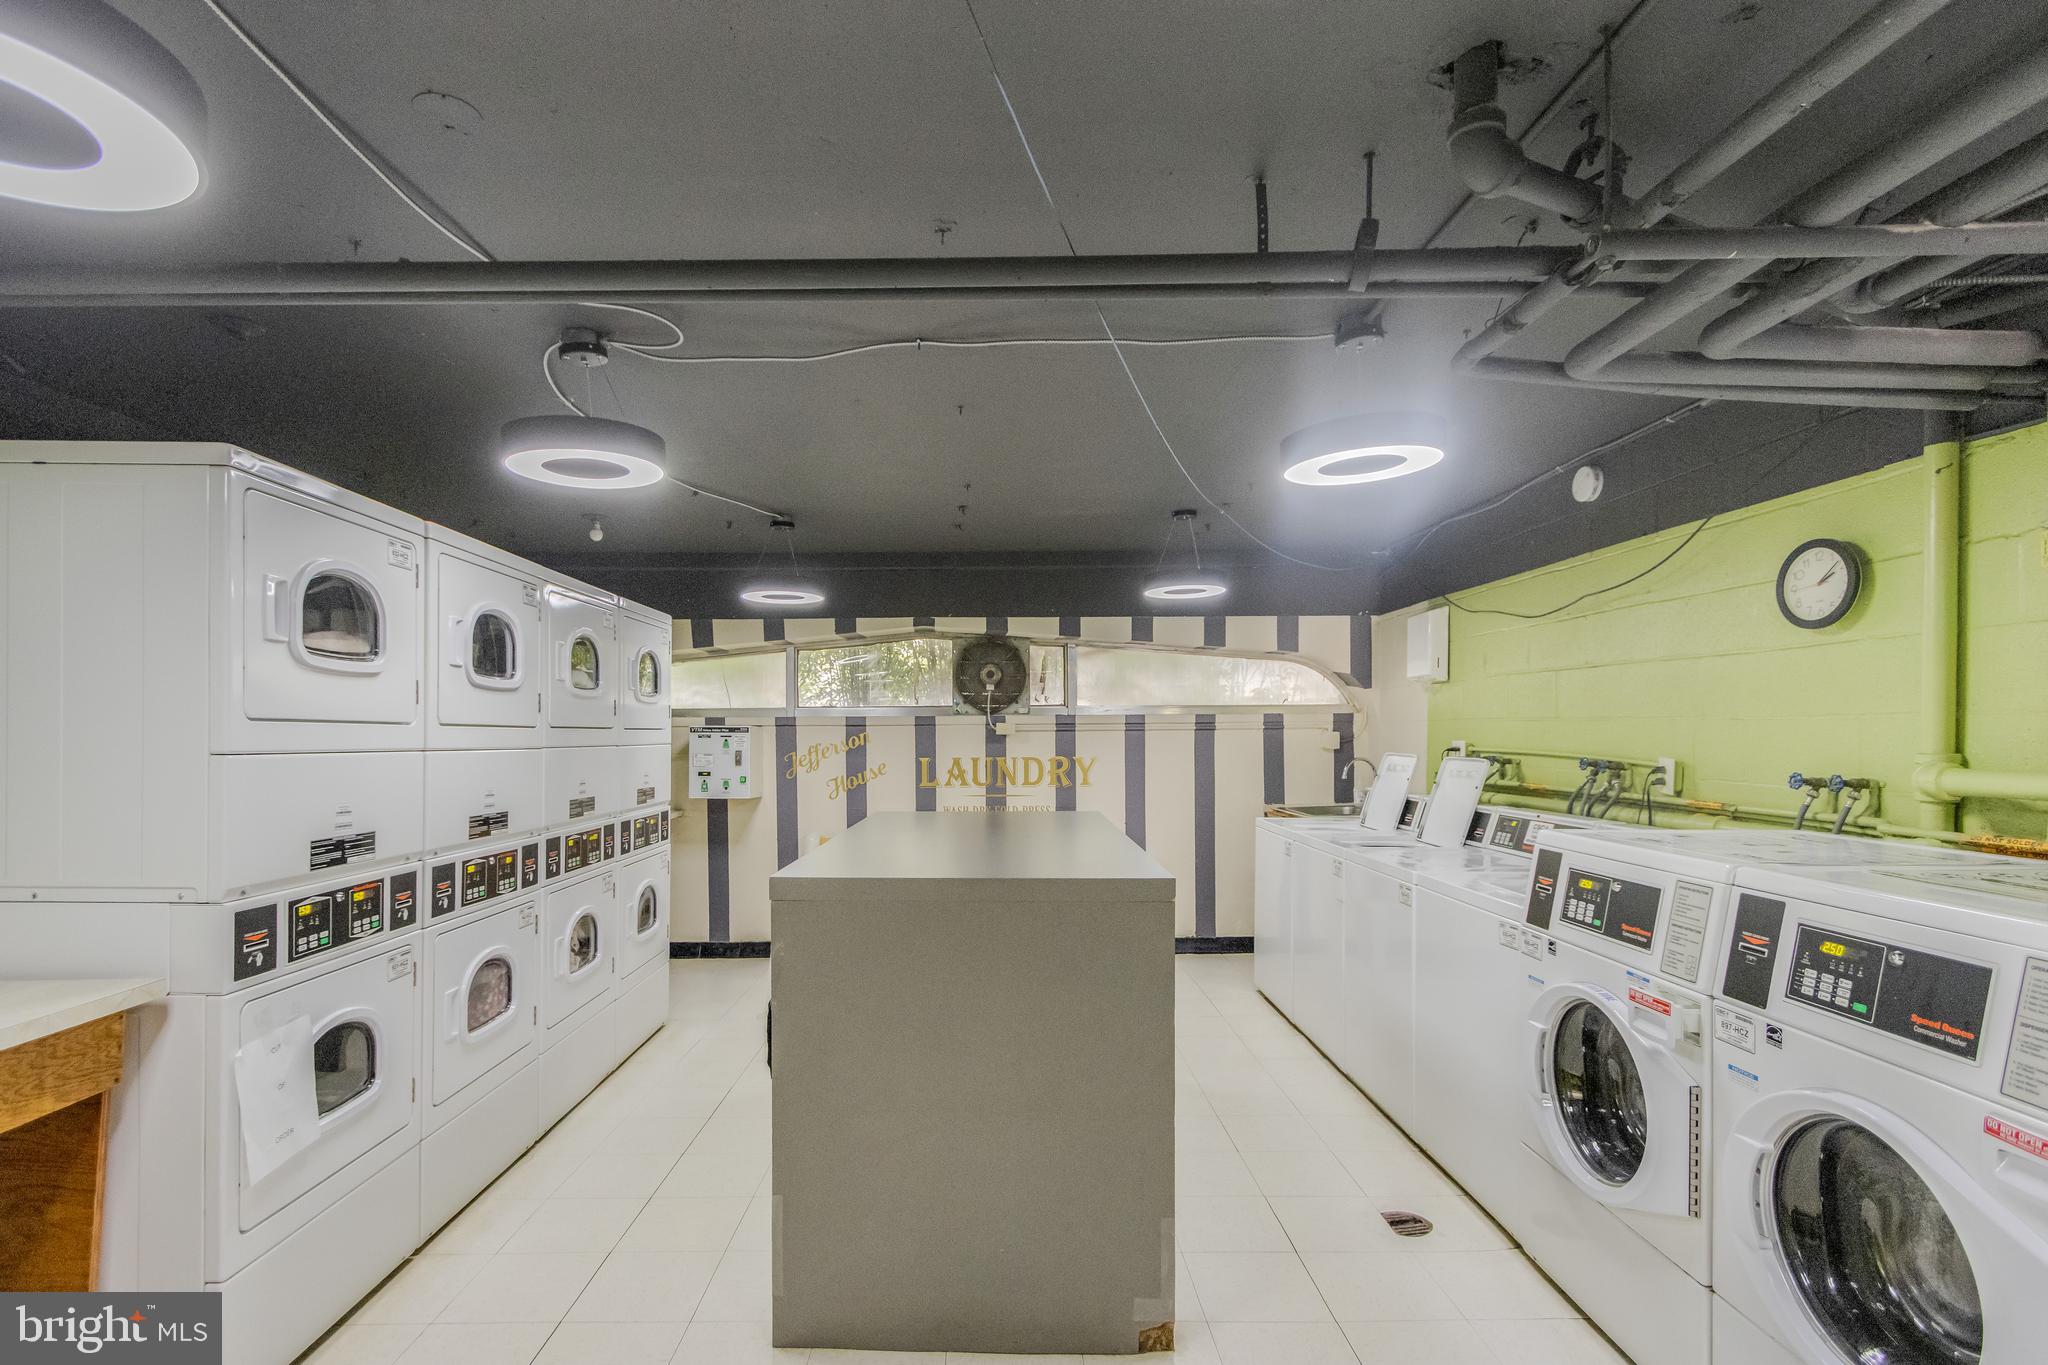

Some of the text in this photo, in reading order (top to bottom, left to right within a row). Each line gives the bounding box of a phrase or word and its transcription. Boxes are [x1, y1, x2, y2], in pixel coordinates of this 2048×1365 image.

[784, 732, 871, 779] Jefferson
[826, 762, 887, 800] House
[919, 756, 1097, 789] LAUNDRY
[1910, 1013, 1975, 1039] Speed Queen
[1913, 1025, 1968, 1047] Commercial Washer
[1987, 1117, 1998, 1129] DO
[2000, 1123, 2016, 1138] NOT
[2018, 1131, 2043, 1150] OPEN
